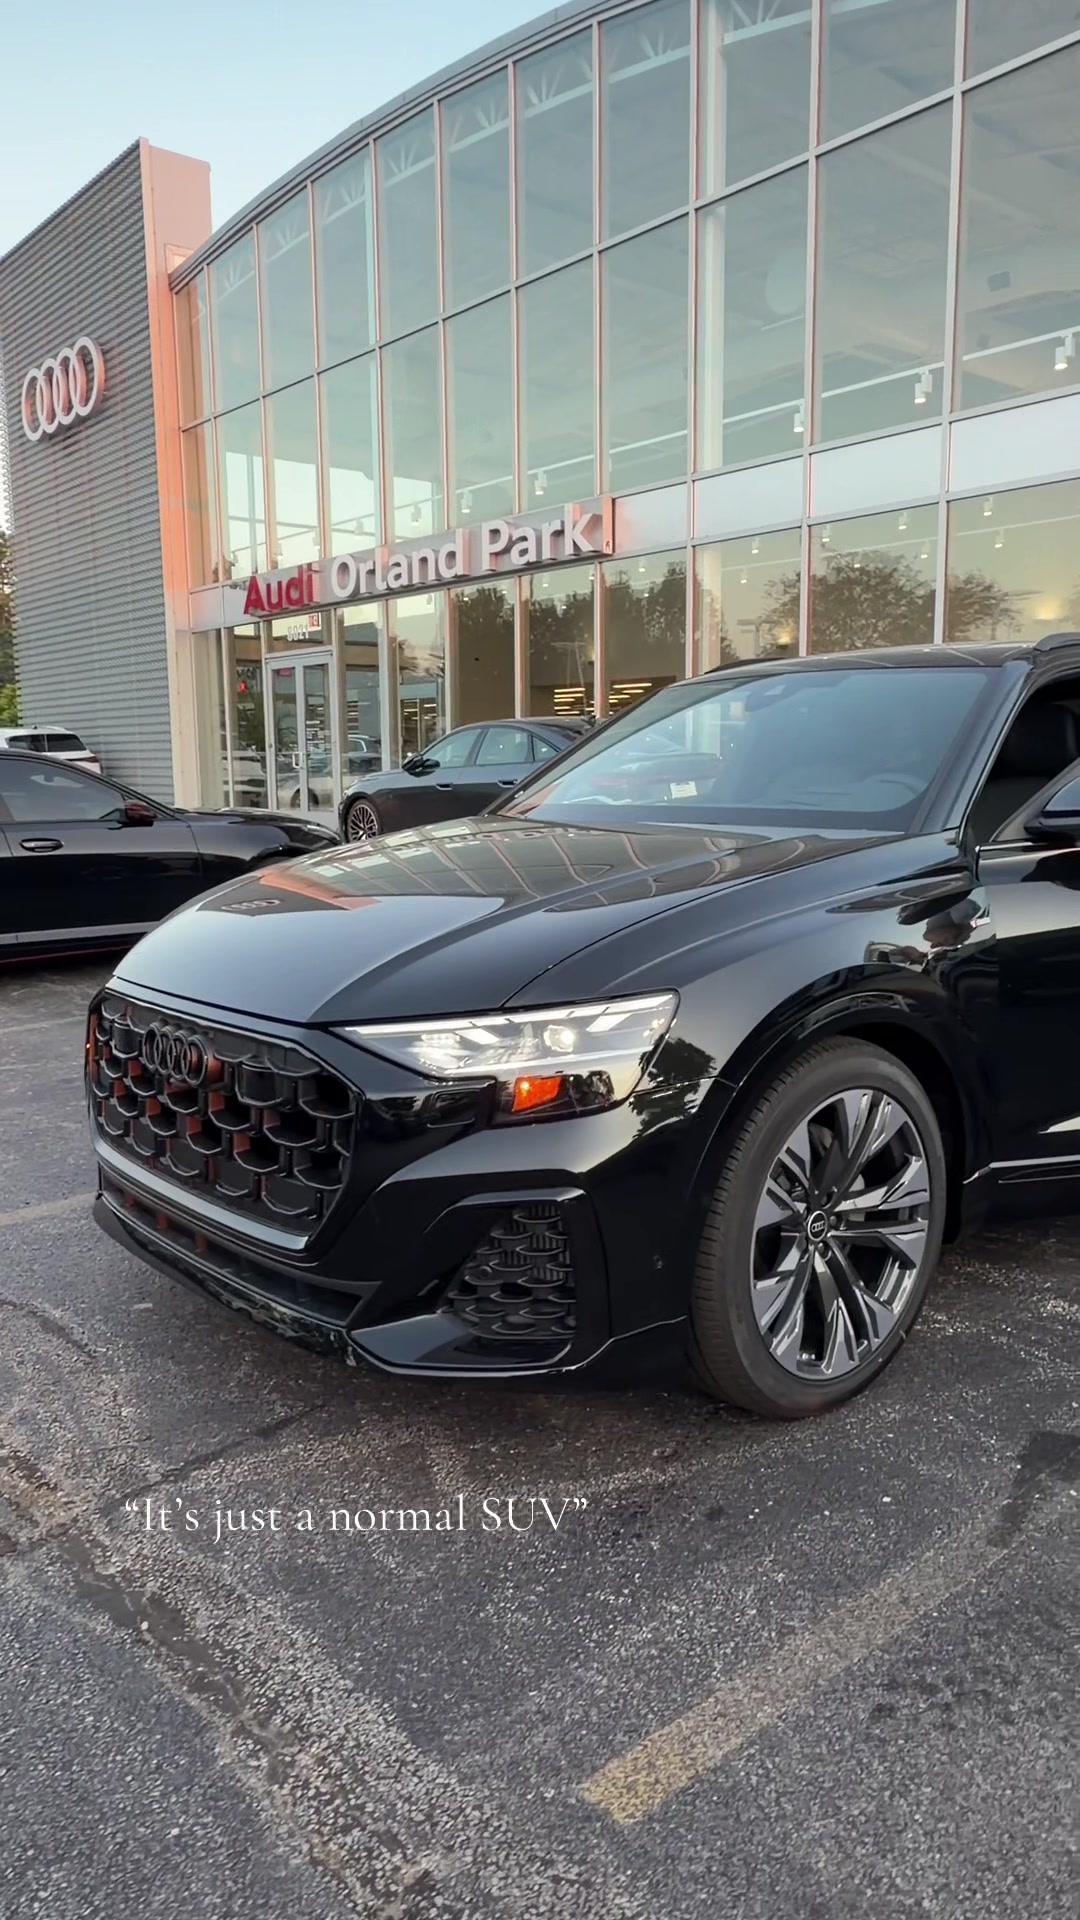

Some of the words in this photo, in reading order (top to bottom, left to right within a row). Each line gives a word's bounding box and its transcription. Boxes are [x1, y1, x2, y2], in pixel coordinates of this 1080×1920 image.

[244, 563, 318, 616] Audi
[331, 528, 468, 599] Orland
[481, 503, 601, 573] Park
